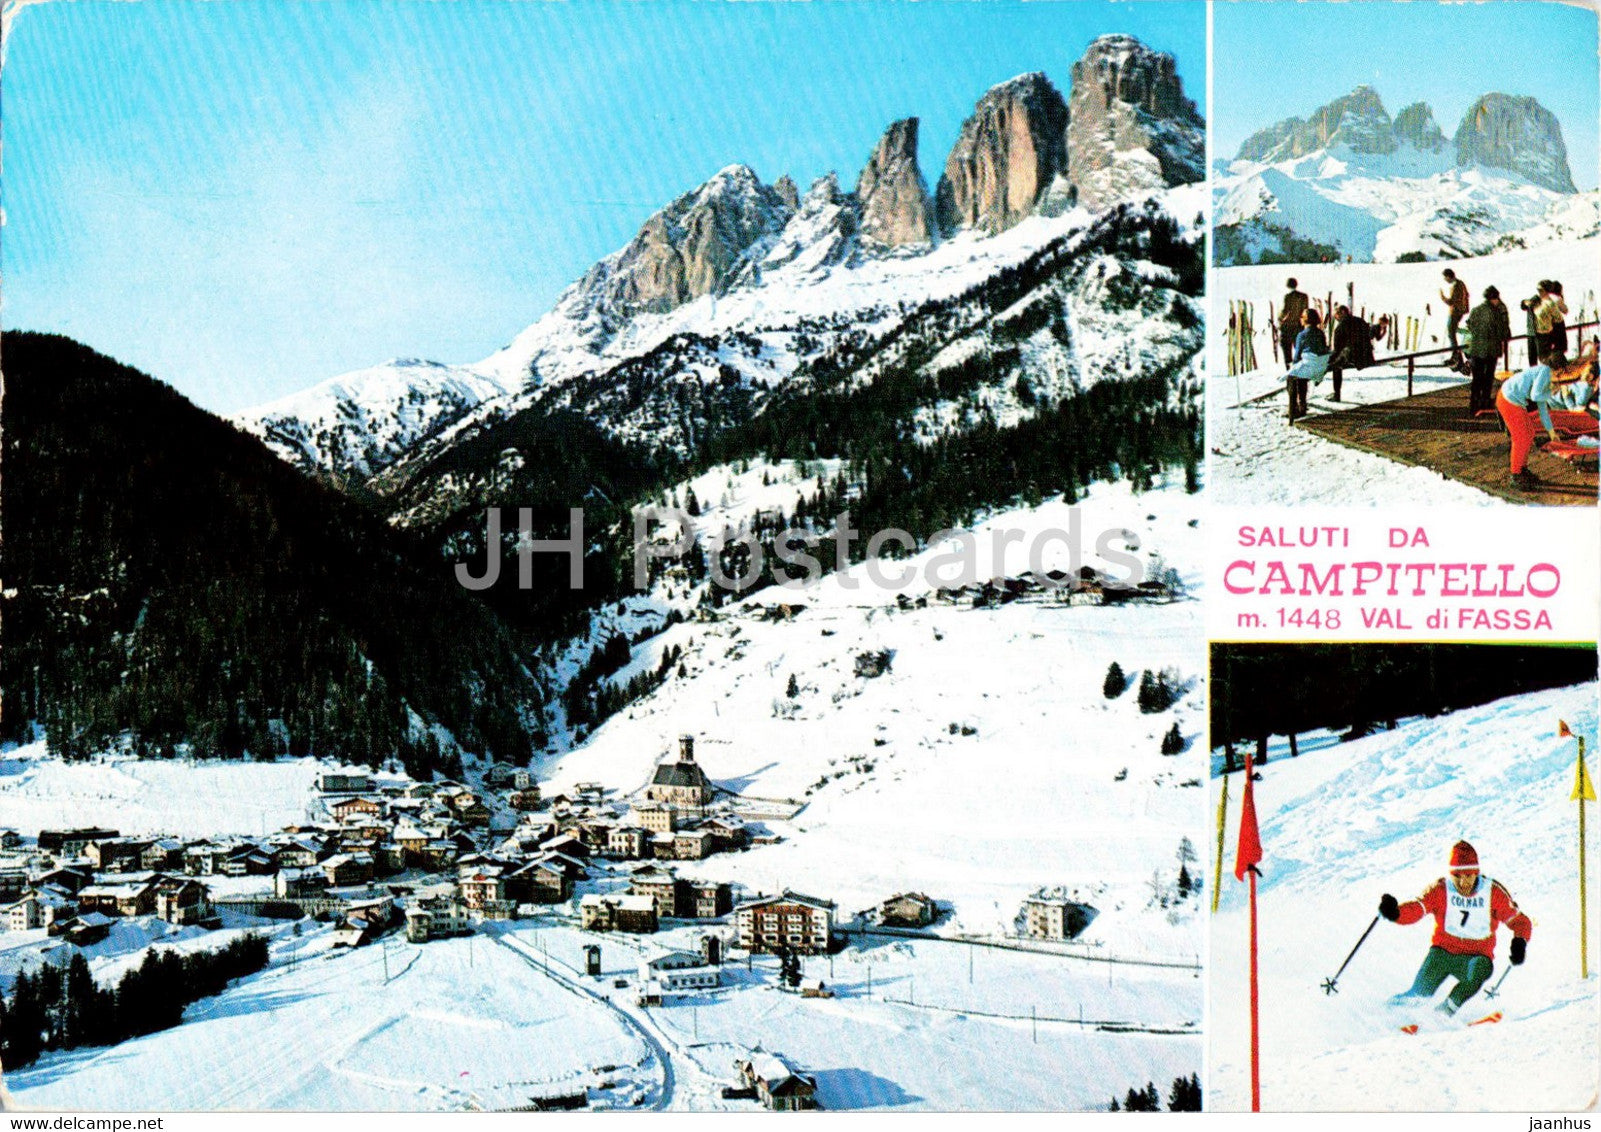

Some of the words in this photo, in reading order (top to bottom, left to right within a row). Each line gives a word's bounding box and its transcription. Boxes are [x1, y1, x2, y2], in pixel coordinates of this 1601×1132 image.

[1238, 526, 1349, 548] SALUTI
[1388, 527, 1430, 548] DA
[1223, 560, 1561, 598] CAMPITELLO
[1237, 612, 1267, 628] m.
[1276, 607, 1342, 630] 1448
[1361, 608, 1412, 629] VAL
[1426, 607, 1449, 629] di
[1458, 608, 1553, 630] FASSA
[1451, 895, 1485, 908] COLMAR
[1460, 910, 1470, 927] 7
